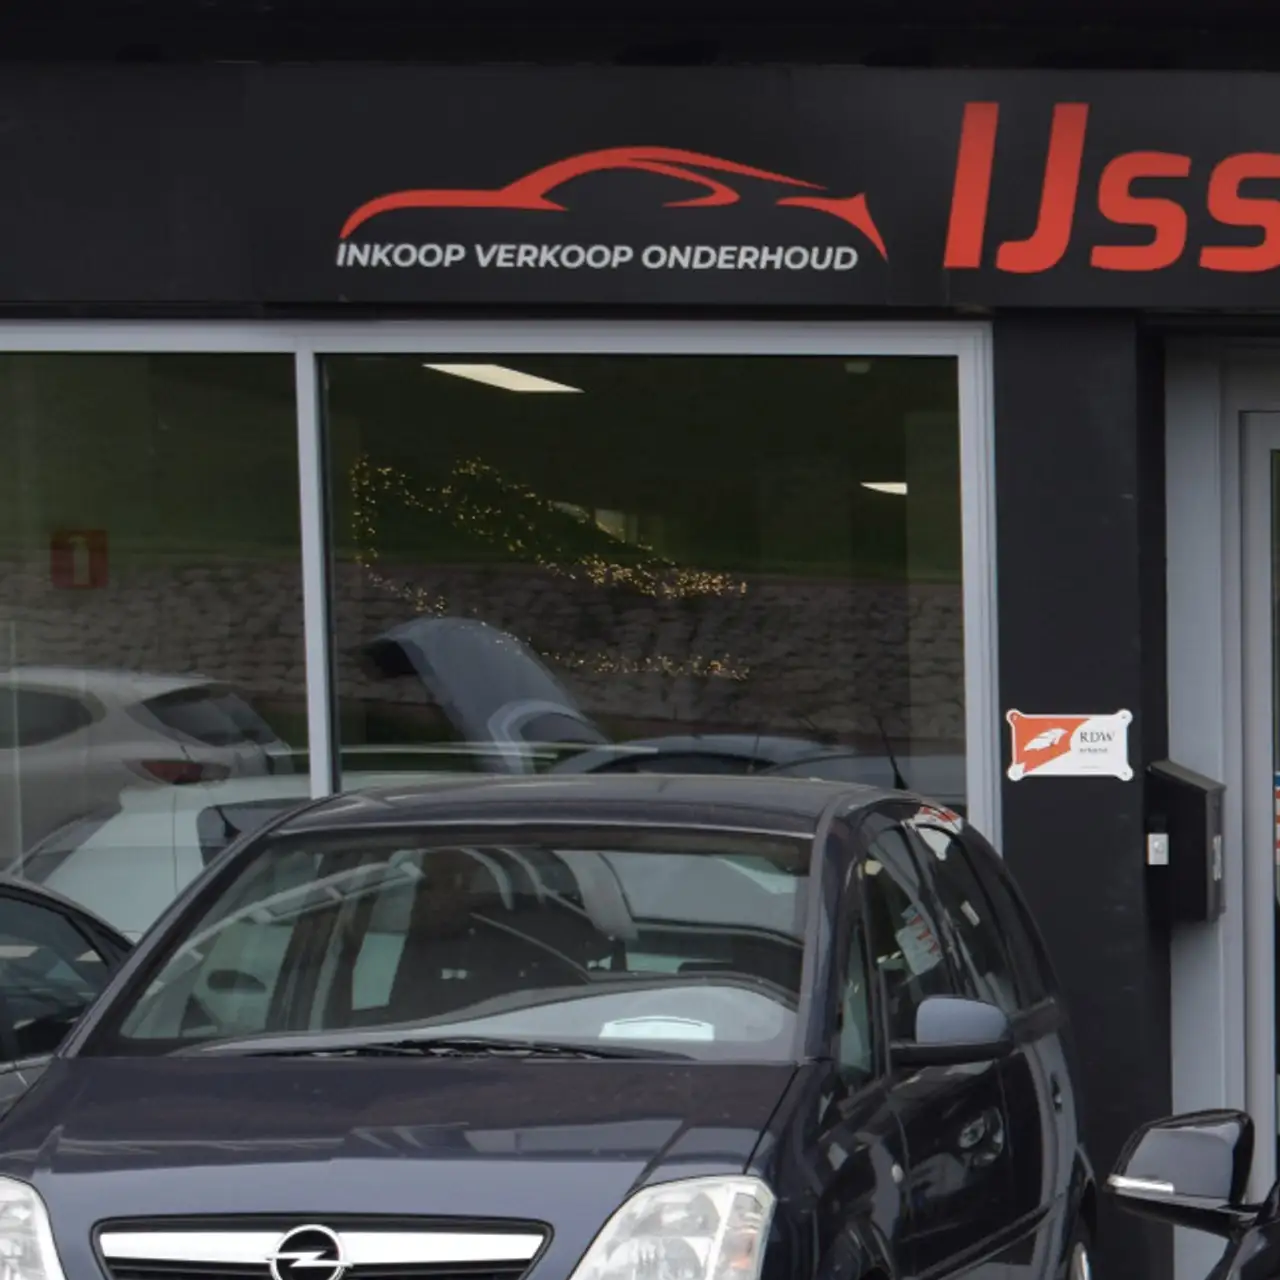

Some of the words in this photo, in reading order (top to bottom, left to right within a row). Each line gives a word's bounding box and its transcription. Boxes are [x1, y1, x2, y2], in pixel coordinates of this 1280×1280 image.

[335, 243, 466, 267] INKOOP
[475, 244, 634, 268] VERKOOP
[641, 245, 858, 270] ONDERHOUD
[1080, 731, 1115, 743] RDW
